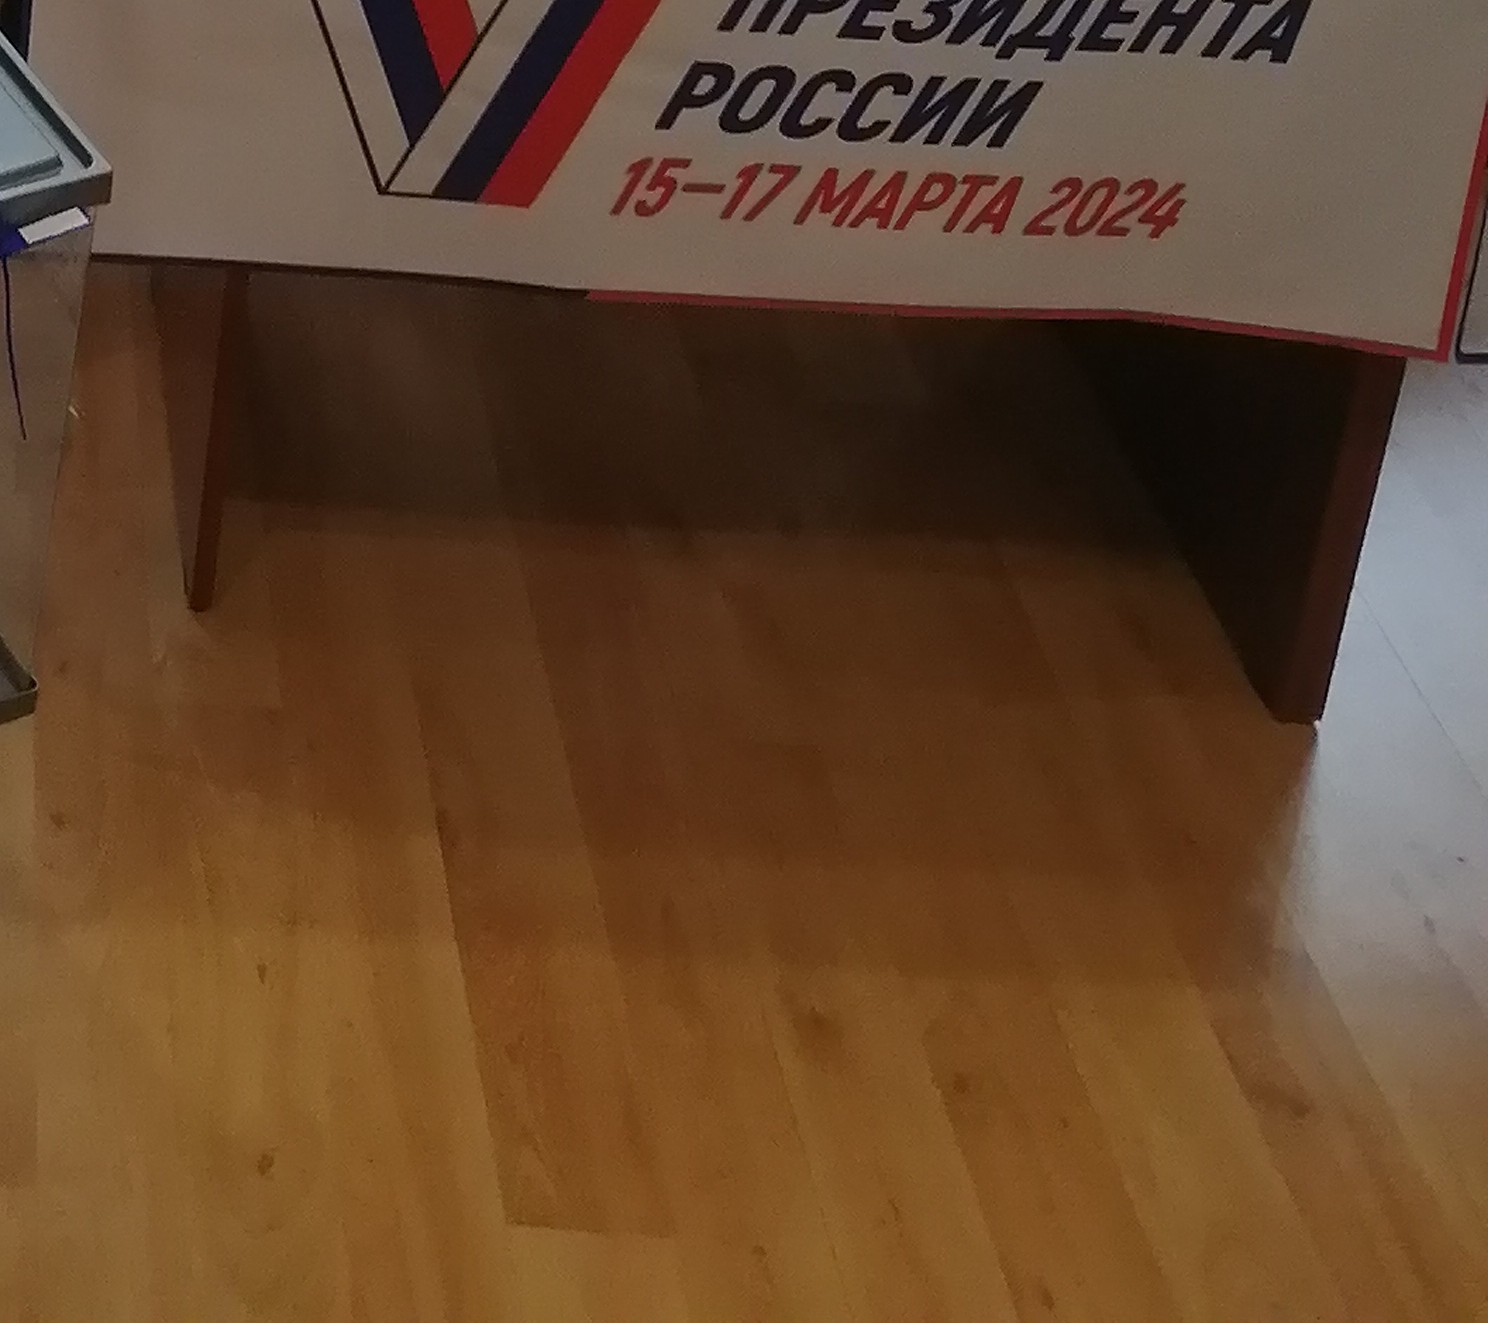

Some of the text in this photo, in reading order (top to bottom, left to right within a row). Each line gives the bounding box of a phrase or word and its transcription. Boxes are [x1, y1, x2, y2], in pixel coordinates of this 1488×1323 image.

[653, 60, 1045, 151] РОССИИ
[792, 166, 1025, 238] МАРТА
[1022, 177, 1189, 241] 2024
